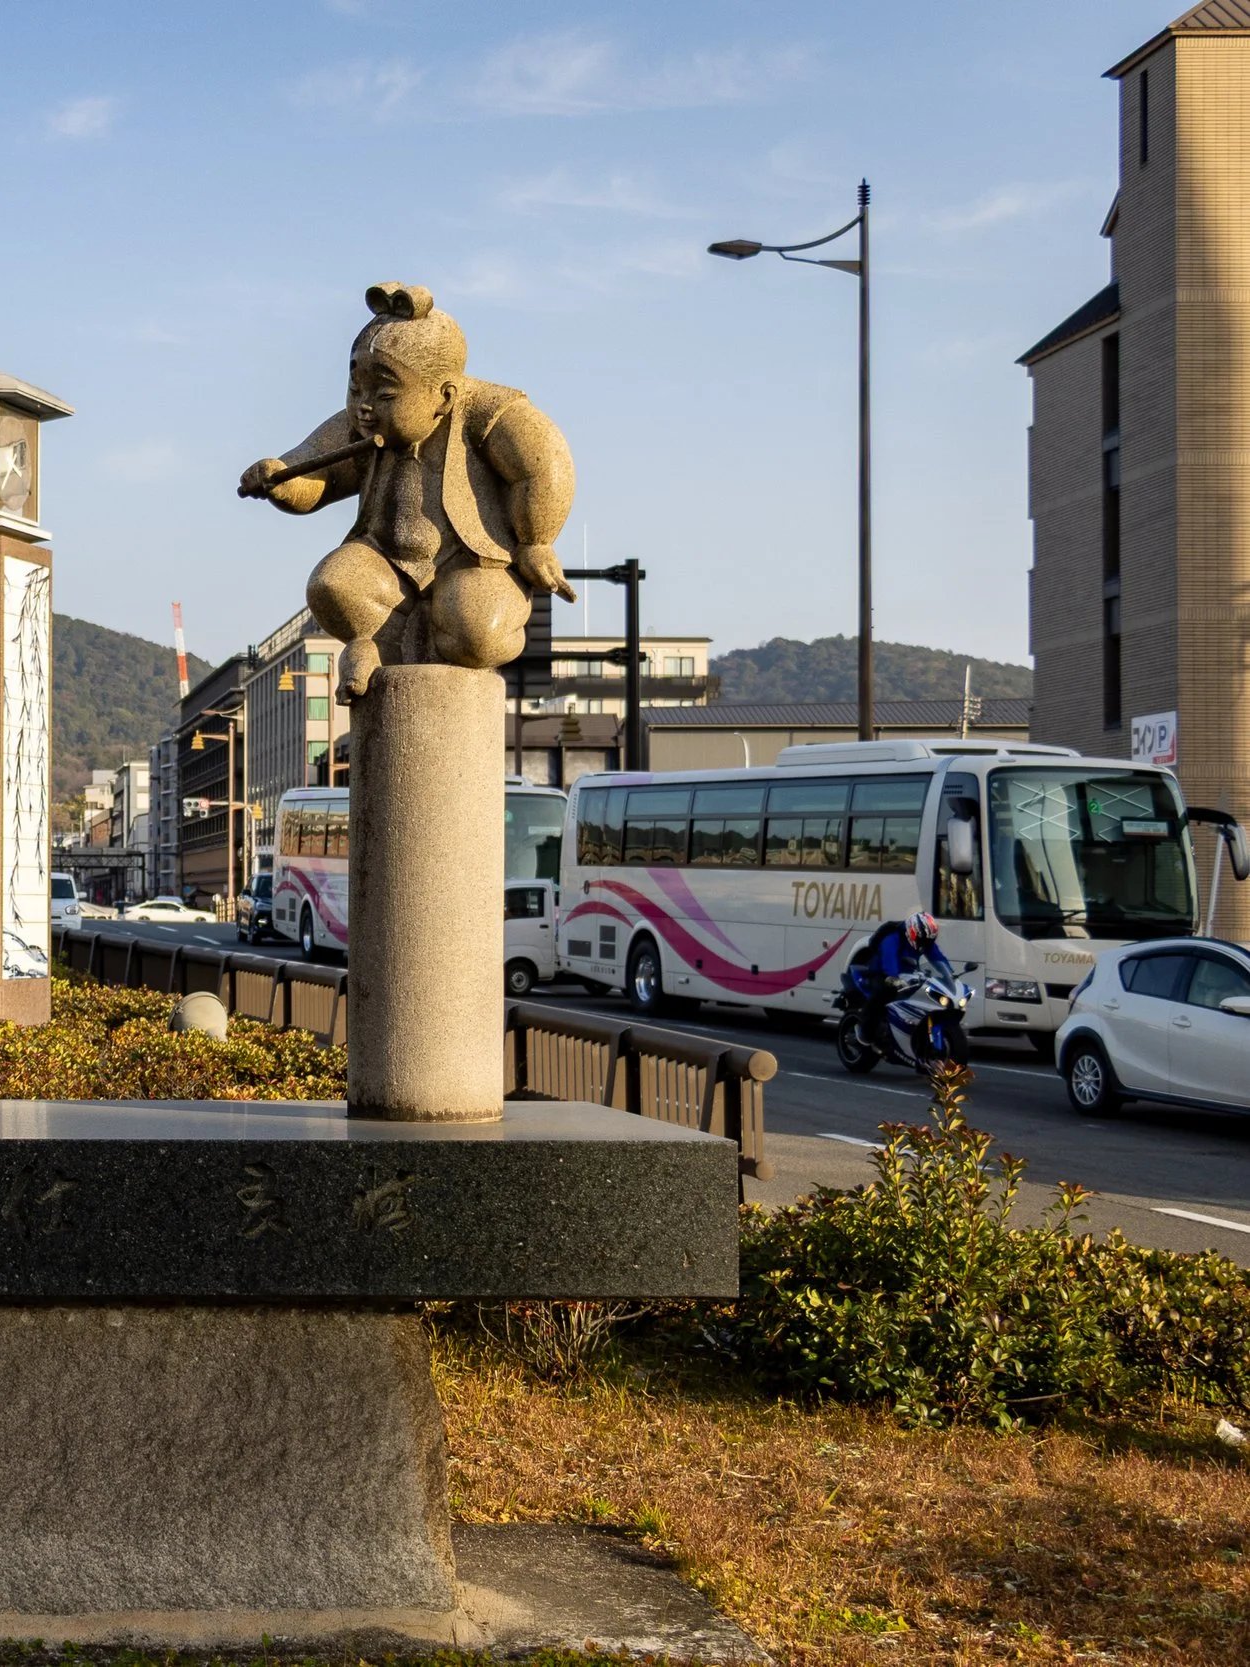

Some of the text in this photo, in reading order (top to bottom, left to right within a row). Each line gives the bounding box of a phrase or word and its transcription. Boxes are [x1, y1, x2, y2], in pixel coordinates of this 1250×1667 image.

[1133, 724, 1167, 756] コイン P
[1090, 803, 1098, 813] 2
[792, 881, 882, 921] TOYAMA
[1043, 952, 1095, 964] TOYAMA
